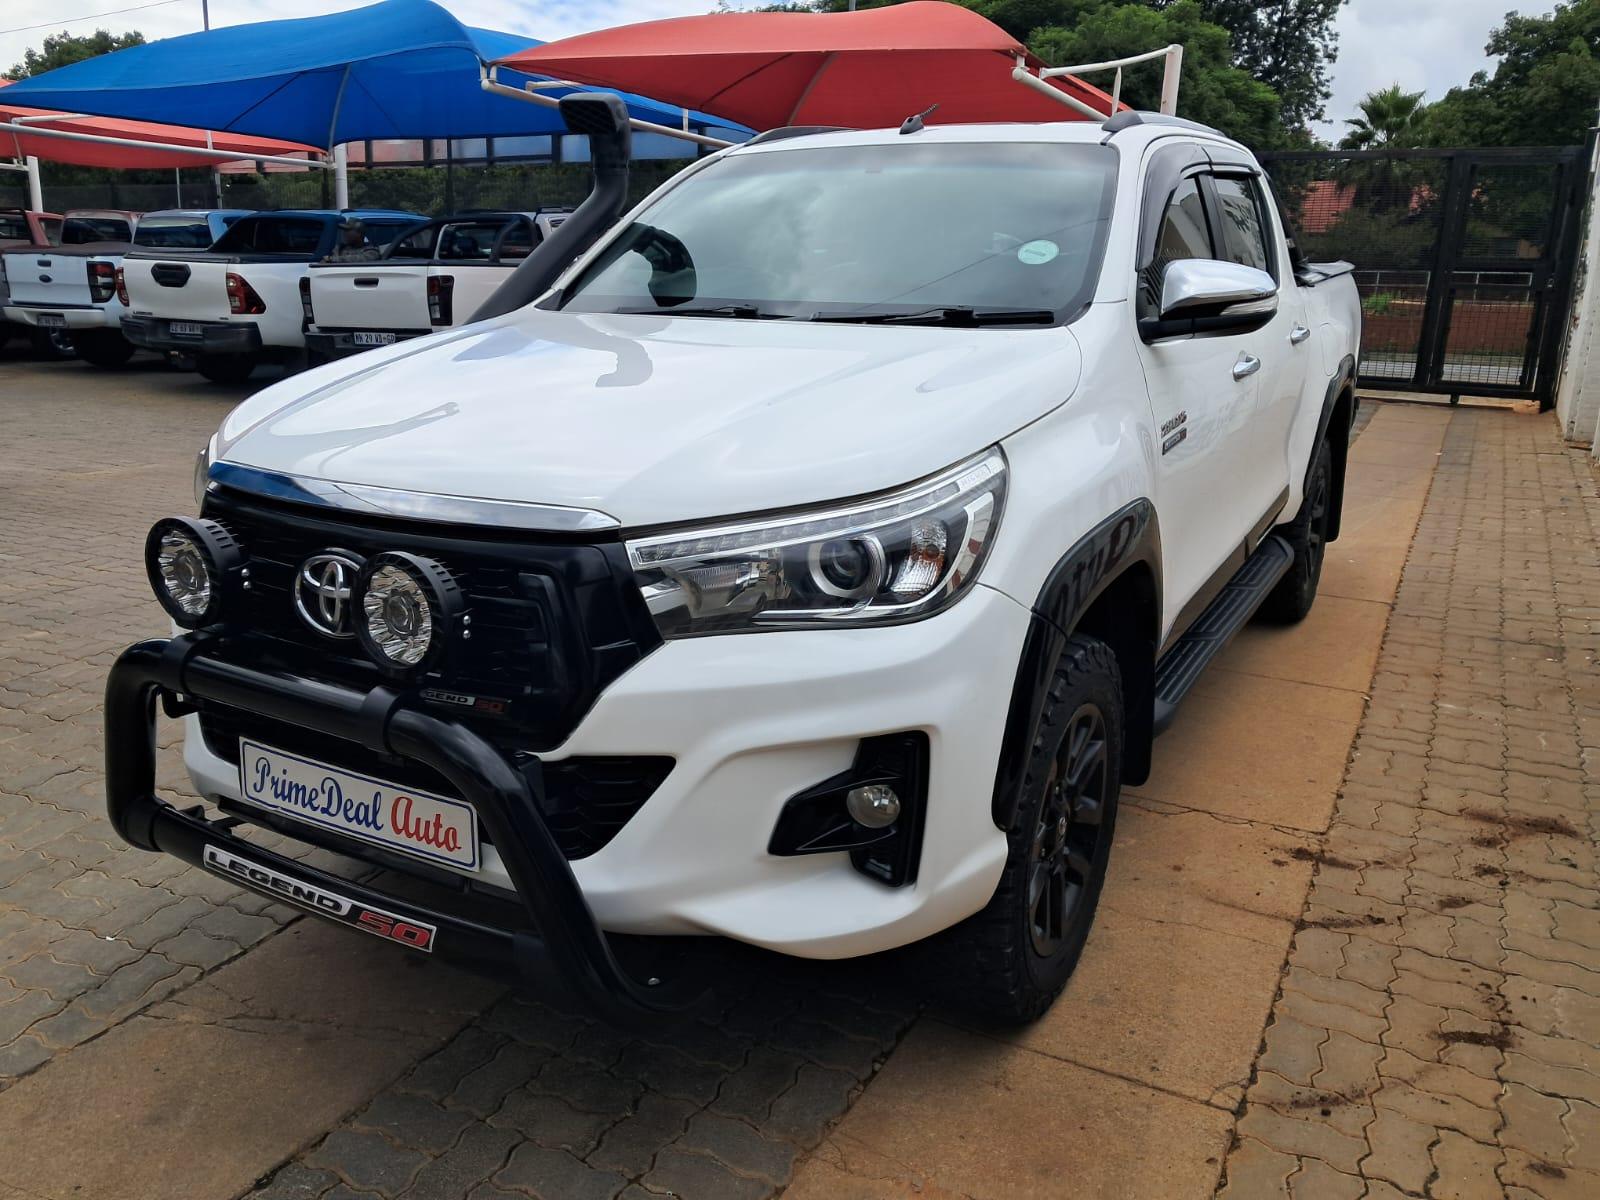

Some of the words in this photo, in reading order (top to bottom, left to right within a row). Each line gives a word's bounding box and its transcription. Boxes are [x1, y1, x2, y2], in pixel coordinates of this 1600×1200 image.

[424, 689, 470, 704] GEND
[252, 756, 385, 832] PrimeDeal
[390, 795, 463, 853] Auto
[208, 849, 344, 915] LEGEND
[355, 909, 431, 948] 50
